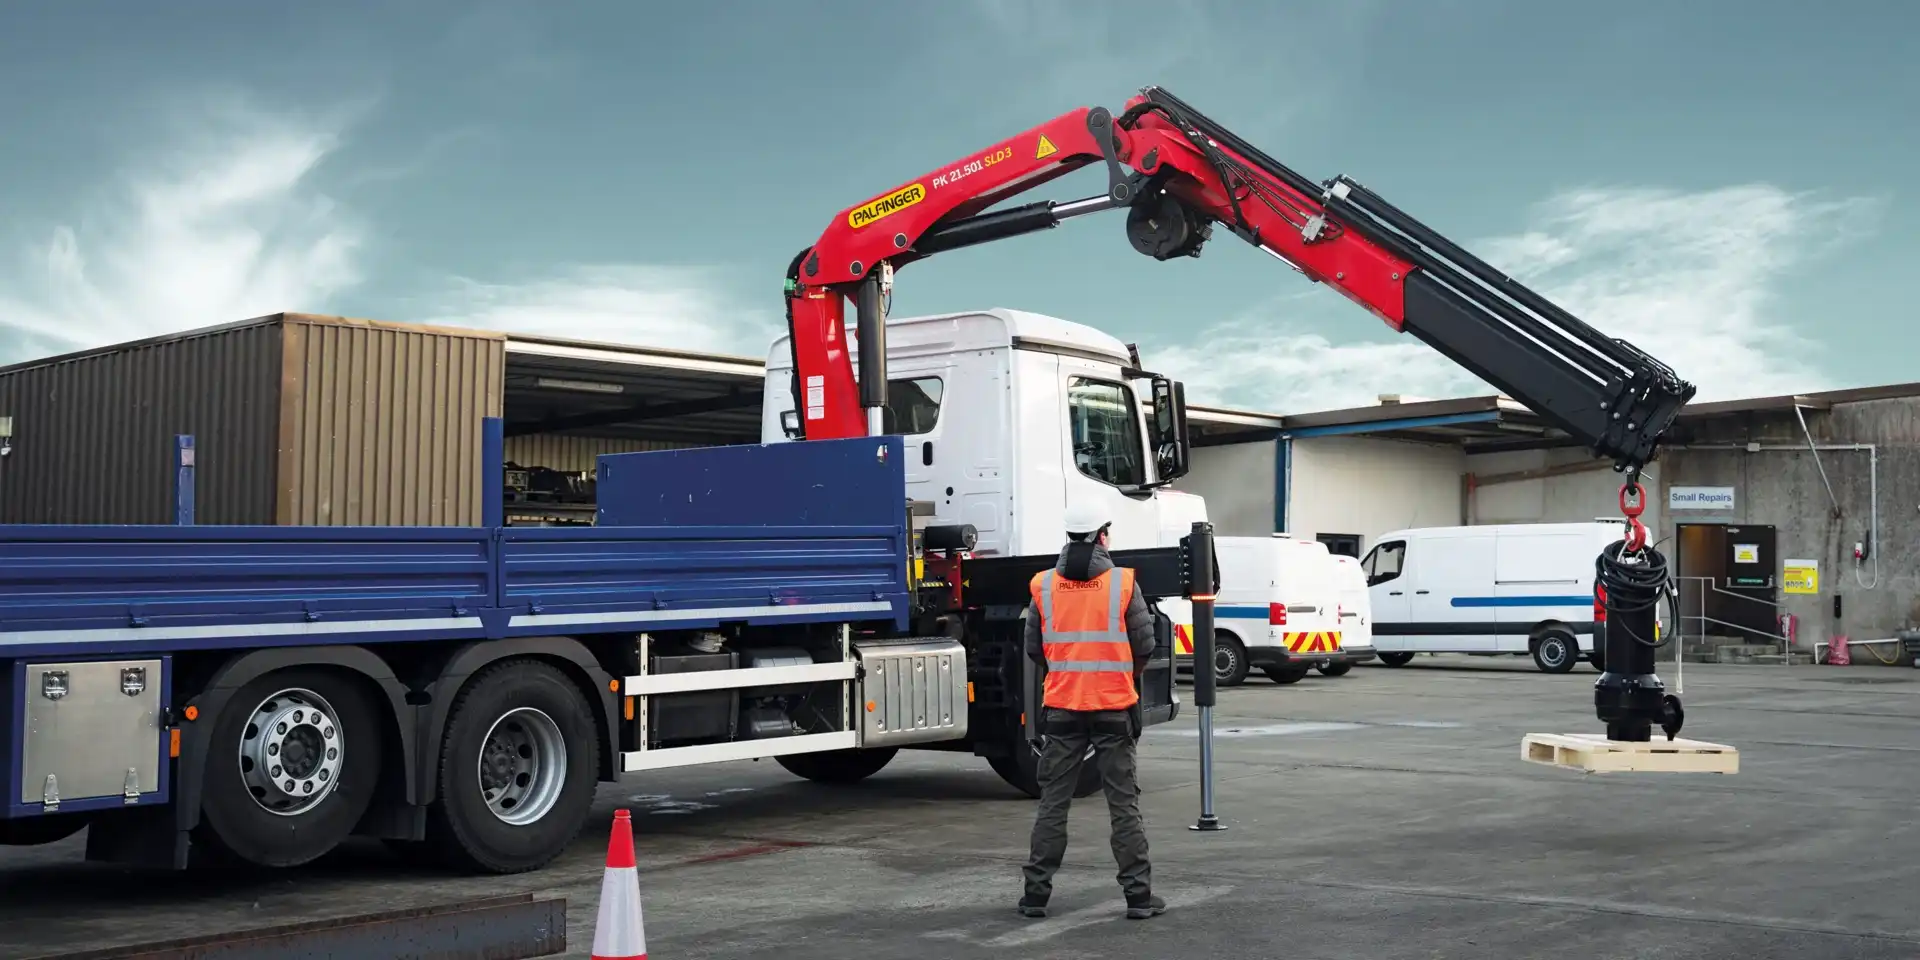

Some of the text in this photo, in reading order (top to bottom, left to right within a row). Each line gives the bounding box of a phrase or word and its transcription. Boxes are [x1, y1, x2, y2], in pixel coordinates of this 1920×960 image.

[932, 174, 949, 190] PK
[949, 159, 984, 182] 21.501
[853, 187, 921, 225] PALFINGER
[1671, 493, 1732, 503] Small Repairs
[1059, 581, 1099, 590] PALFINGER
